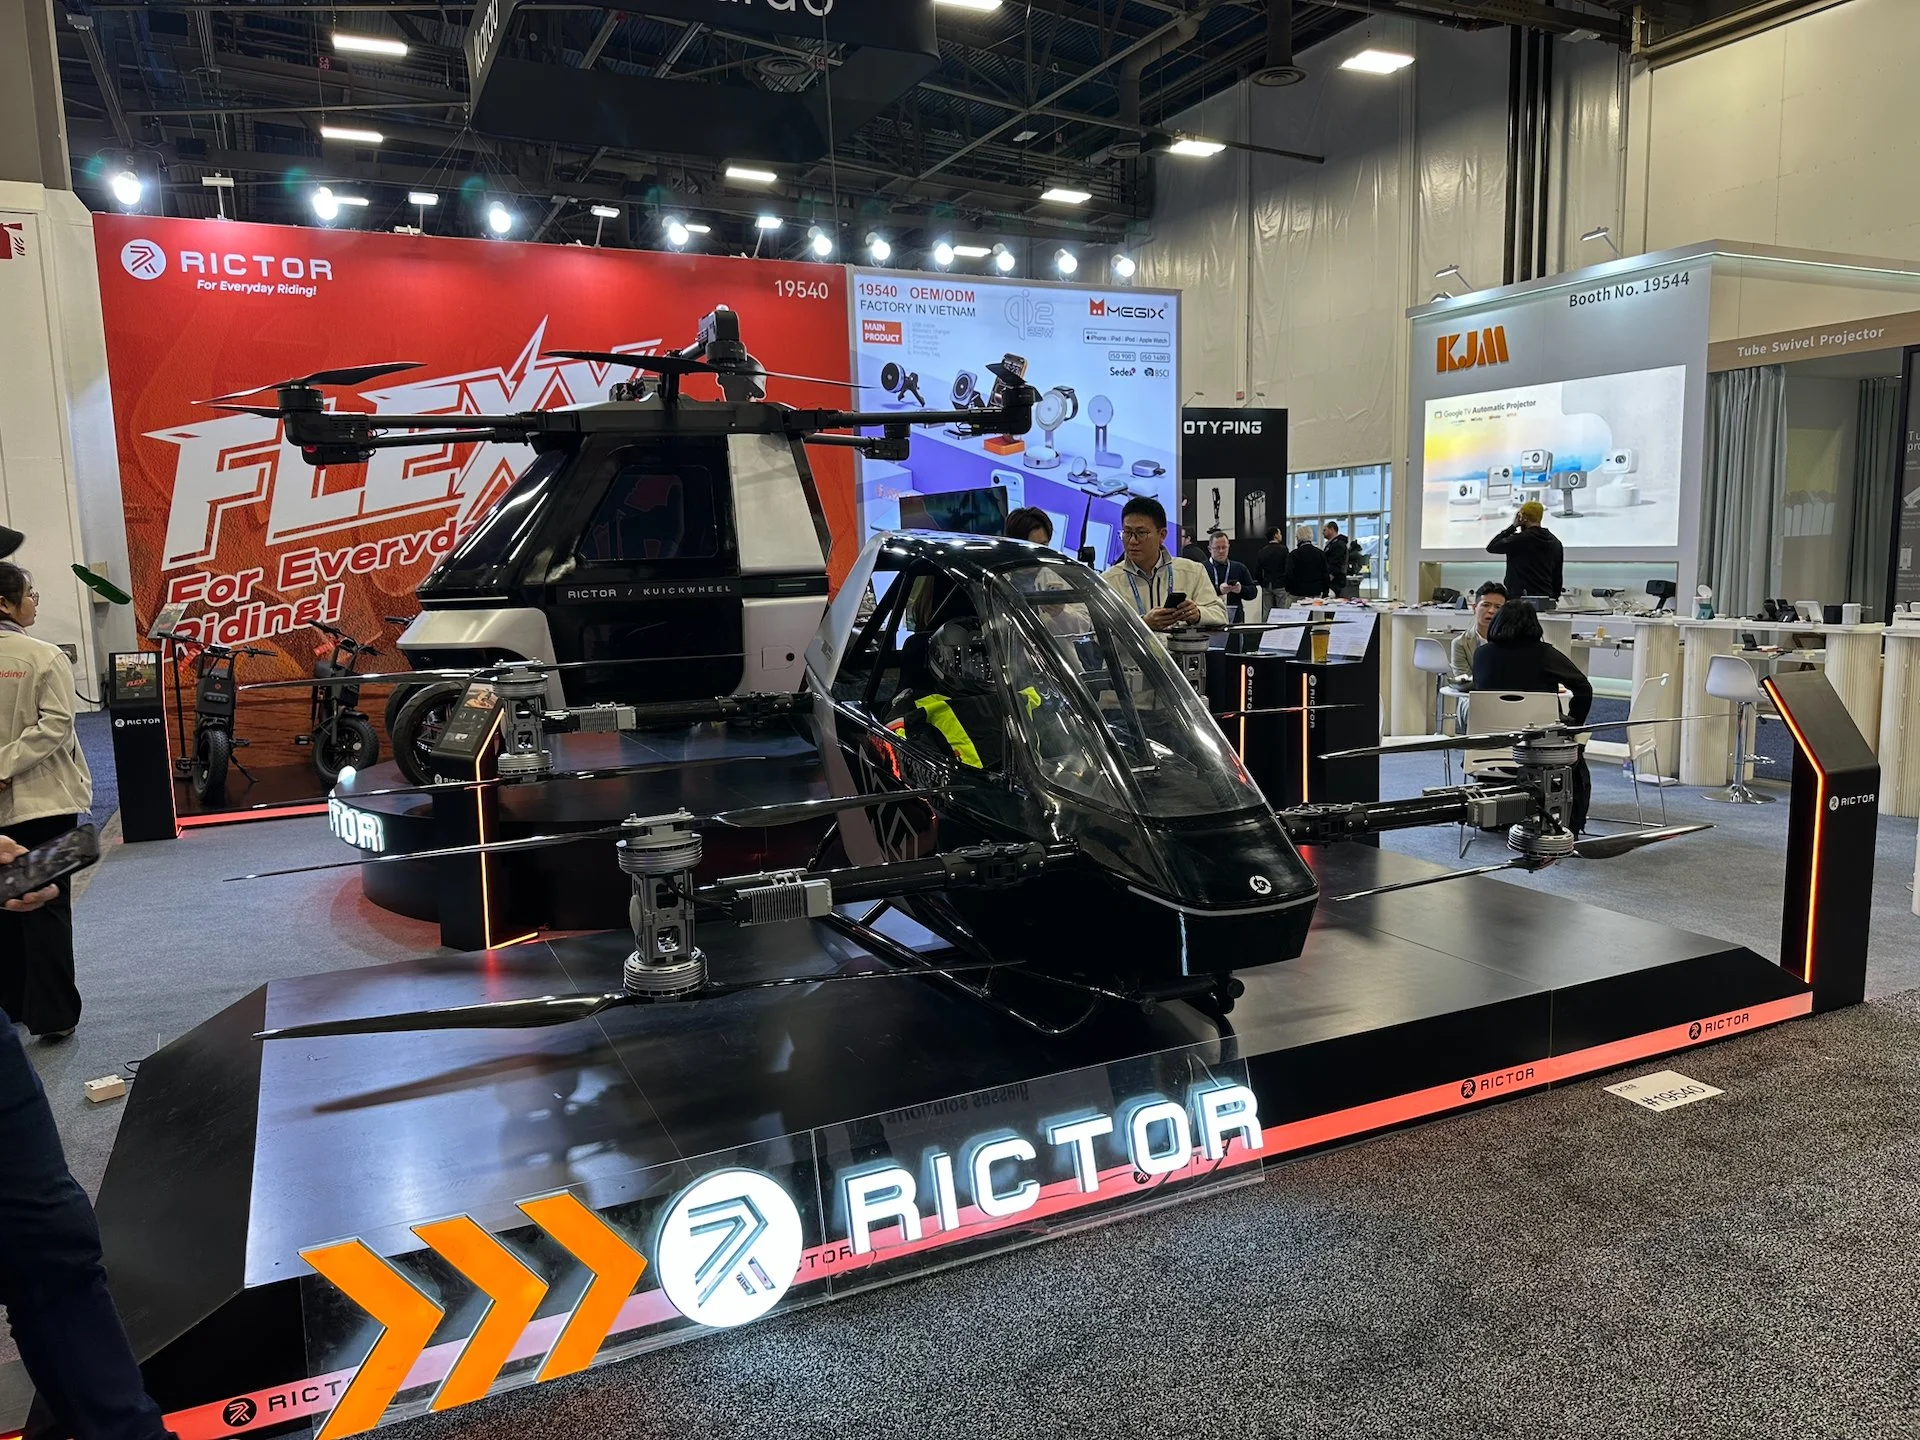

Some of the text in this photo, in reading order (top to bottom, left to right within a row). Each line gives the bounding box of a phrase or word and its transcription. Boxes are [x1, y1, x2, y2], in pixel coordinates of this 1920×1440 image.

[180, 251, 333, 280] RICTOR
[197, 279, 317, 298] For Everyday Riding!
[774, 279, 829, 300] 19540
[859, 283, 975, 303] 19540 OEM/ODM
[1569, 271, 1690, 307] Booth No. 19544
[860, 300, 976, 317] FACTORY IN VIETNAM
[864, 323, 886, 332] MAIN
[865, 333, 900, 343] PRODUCT
[1437, 325, 1510, 373] KJM
[1737, 327, 1885, 357] Tube Swivel Projector
[1142, 353, 1152, 361] ISO
[1110, 366, 1136, 377] Sedex
[1154, 368, 1170, 378] BSCI
[1443, 409, 1463, 419] Google
[1472, 402, 1505, 414] Automatic
[1506, 399, 1537, 410] Projector
[1183, 420, 1262, 435] OTYPING
[168, 566, 264, 607] For
[568, 588, 617, 599] RICTOR
[643, 585, 732, 596] KUICKWHEEL
[161, 582, 345, 663] Riding!
[127, 718, 161, 726] RICTOR
[1840, 793, 1875, 807] RICTOR
[328, 797, 386, 853] TOR
[1705, 1012, 1749, 1034] RICTOR
[1480, 1068, 1535, 1091] RICTOR
[1640, 1084, 1706, 1107] #19540
[844, 1083, 1264, 1256] RICTOR
[797, 1245, 853, 1272] TOR
[269, 1377, 354, 1412] RICT
